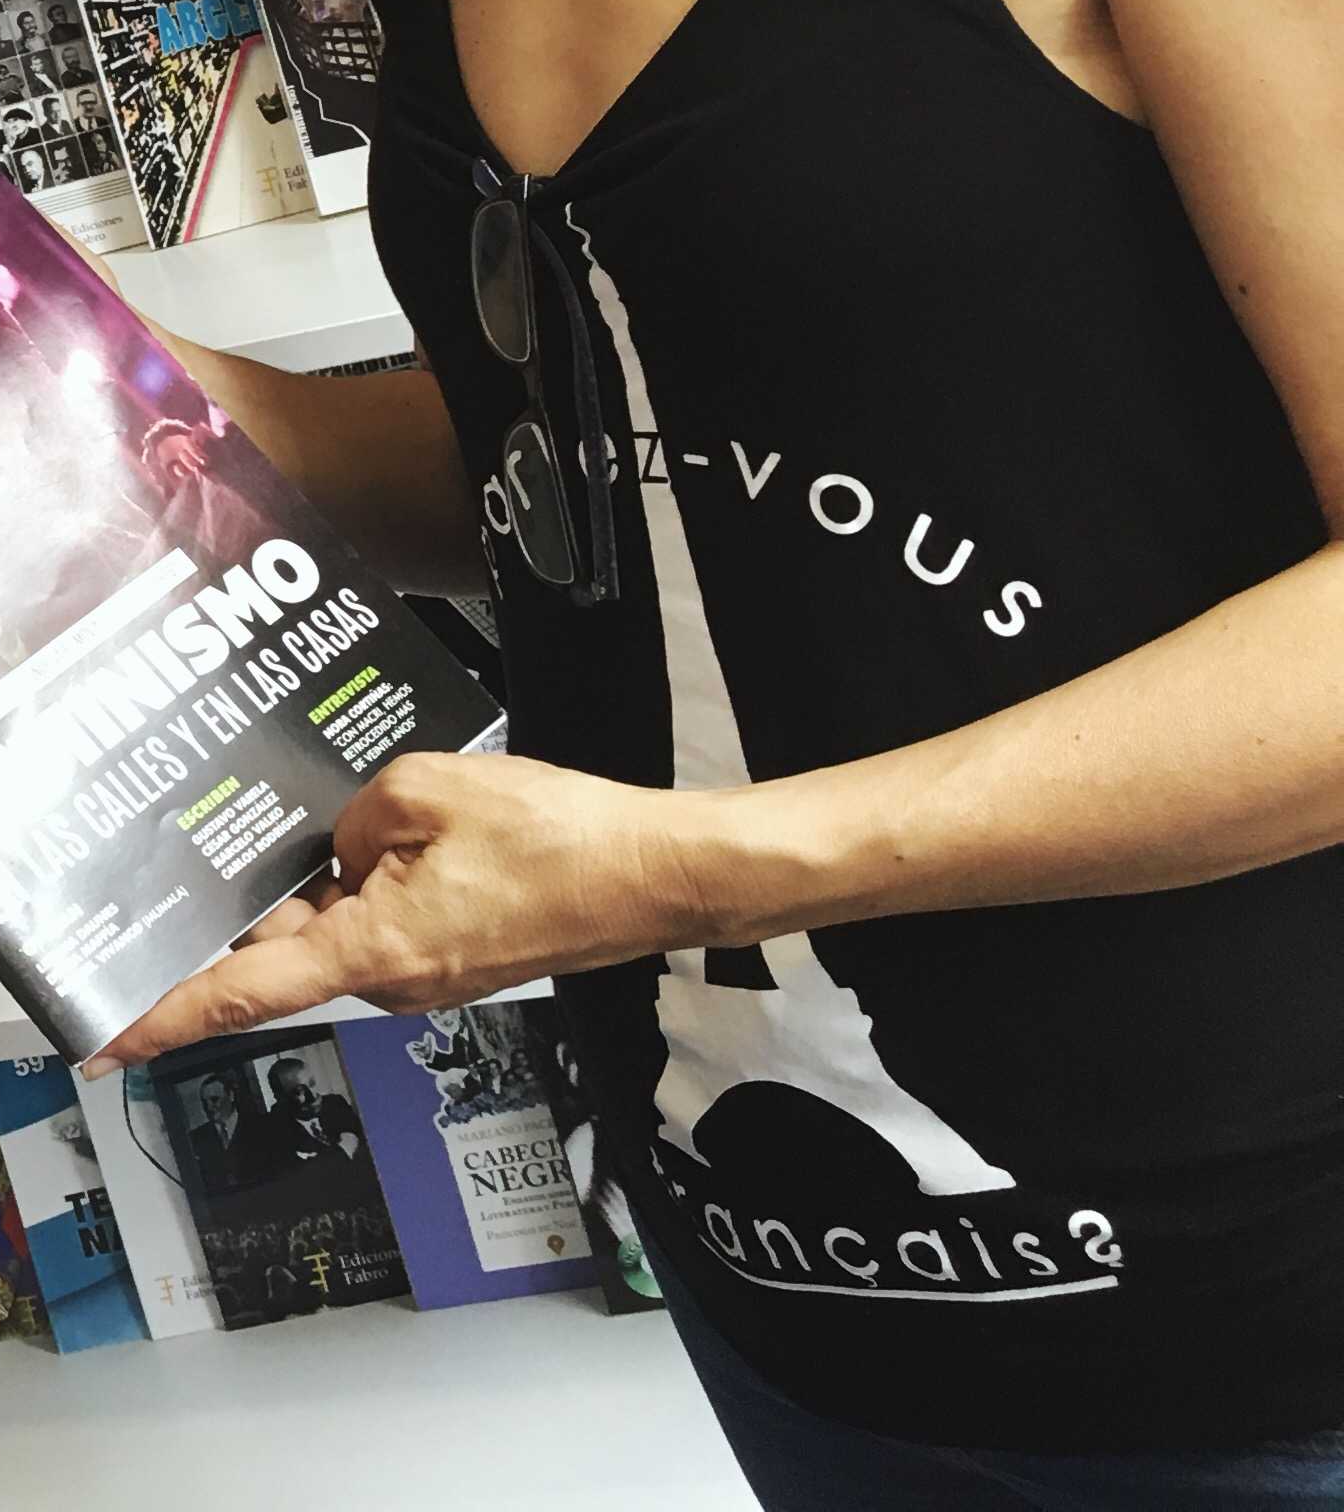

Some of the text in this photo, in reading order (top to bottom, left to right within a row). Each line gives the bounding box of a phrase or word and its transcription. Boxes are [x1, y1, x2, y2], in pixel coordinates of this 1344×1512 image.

[73, 587, 380, 840] CALLES Y EN LAS CASAS
[308, 665, 381, 725] ENTREVISTA
[382, 682, 414, 710] HEMOS
[342, 714, 398, 761] RETROCEDIDO
[351, 736, 394, 773] DE VEINTE
[176, 775, 241, 831] ESCRIBEN
[192, 807, 236, 846] GUSTAVO
[211, 806, 285, 870] MARCELO VALKO
[220, 805, 309, 881] CARLOS RODRÍGUEZ
[14, 1055, 45, 1078] 59
